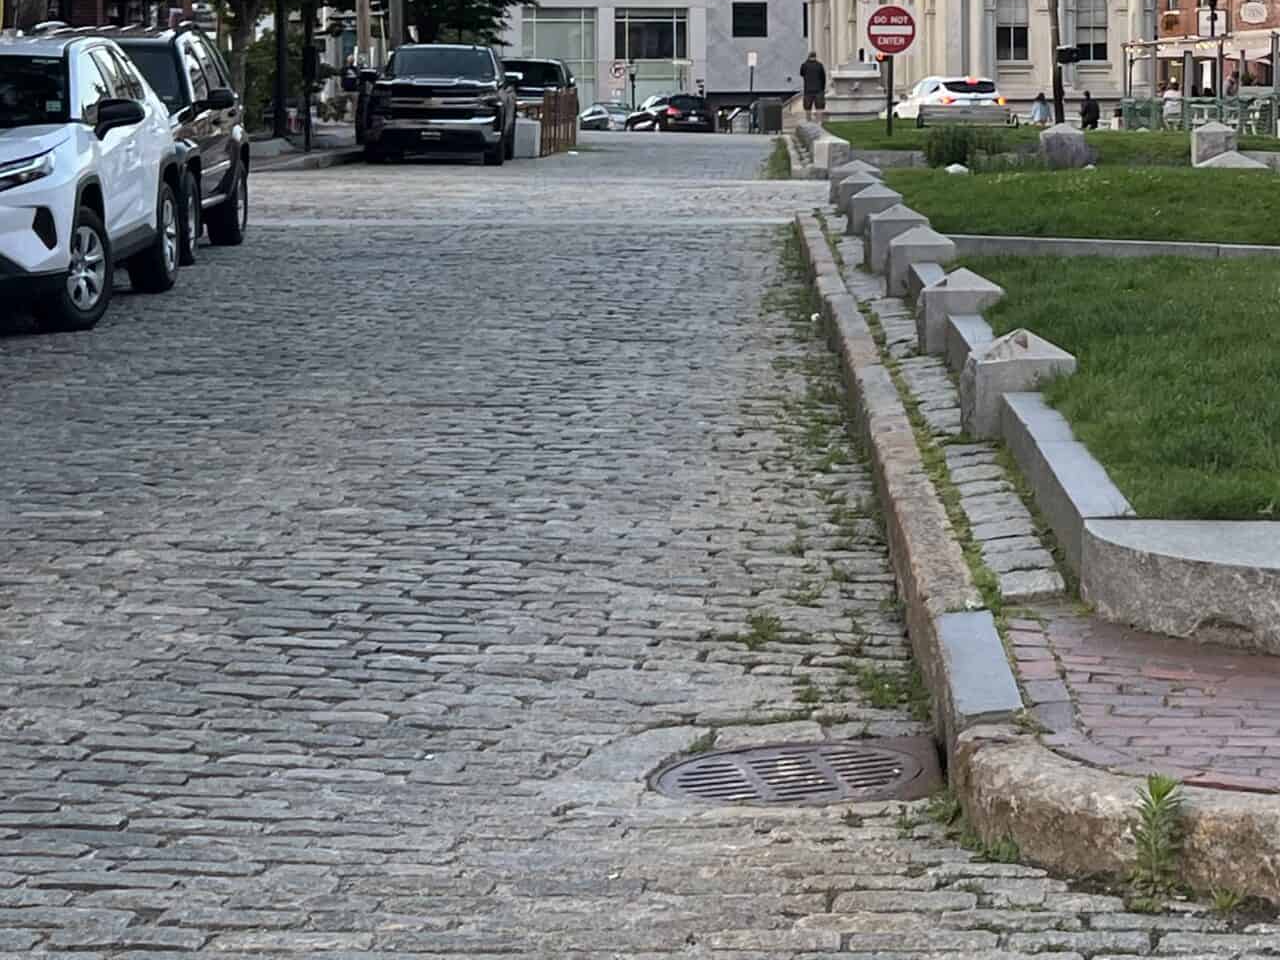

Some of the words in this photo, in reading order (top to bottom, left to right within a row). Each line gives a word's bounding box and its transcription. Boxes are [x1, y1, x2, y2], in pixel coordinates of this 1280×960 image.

[873, 15, 888, 25] DO
[890, 15, 908, 25] NOT
[878, 36, 905, 46] ENTER
